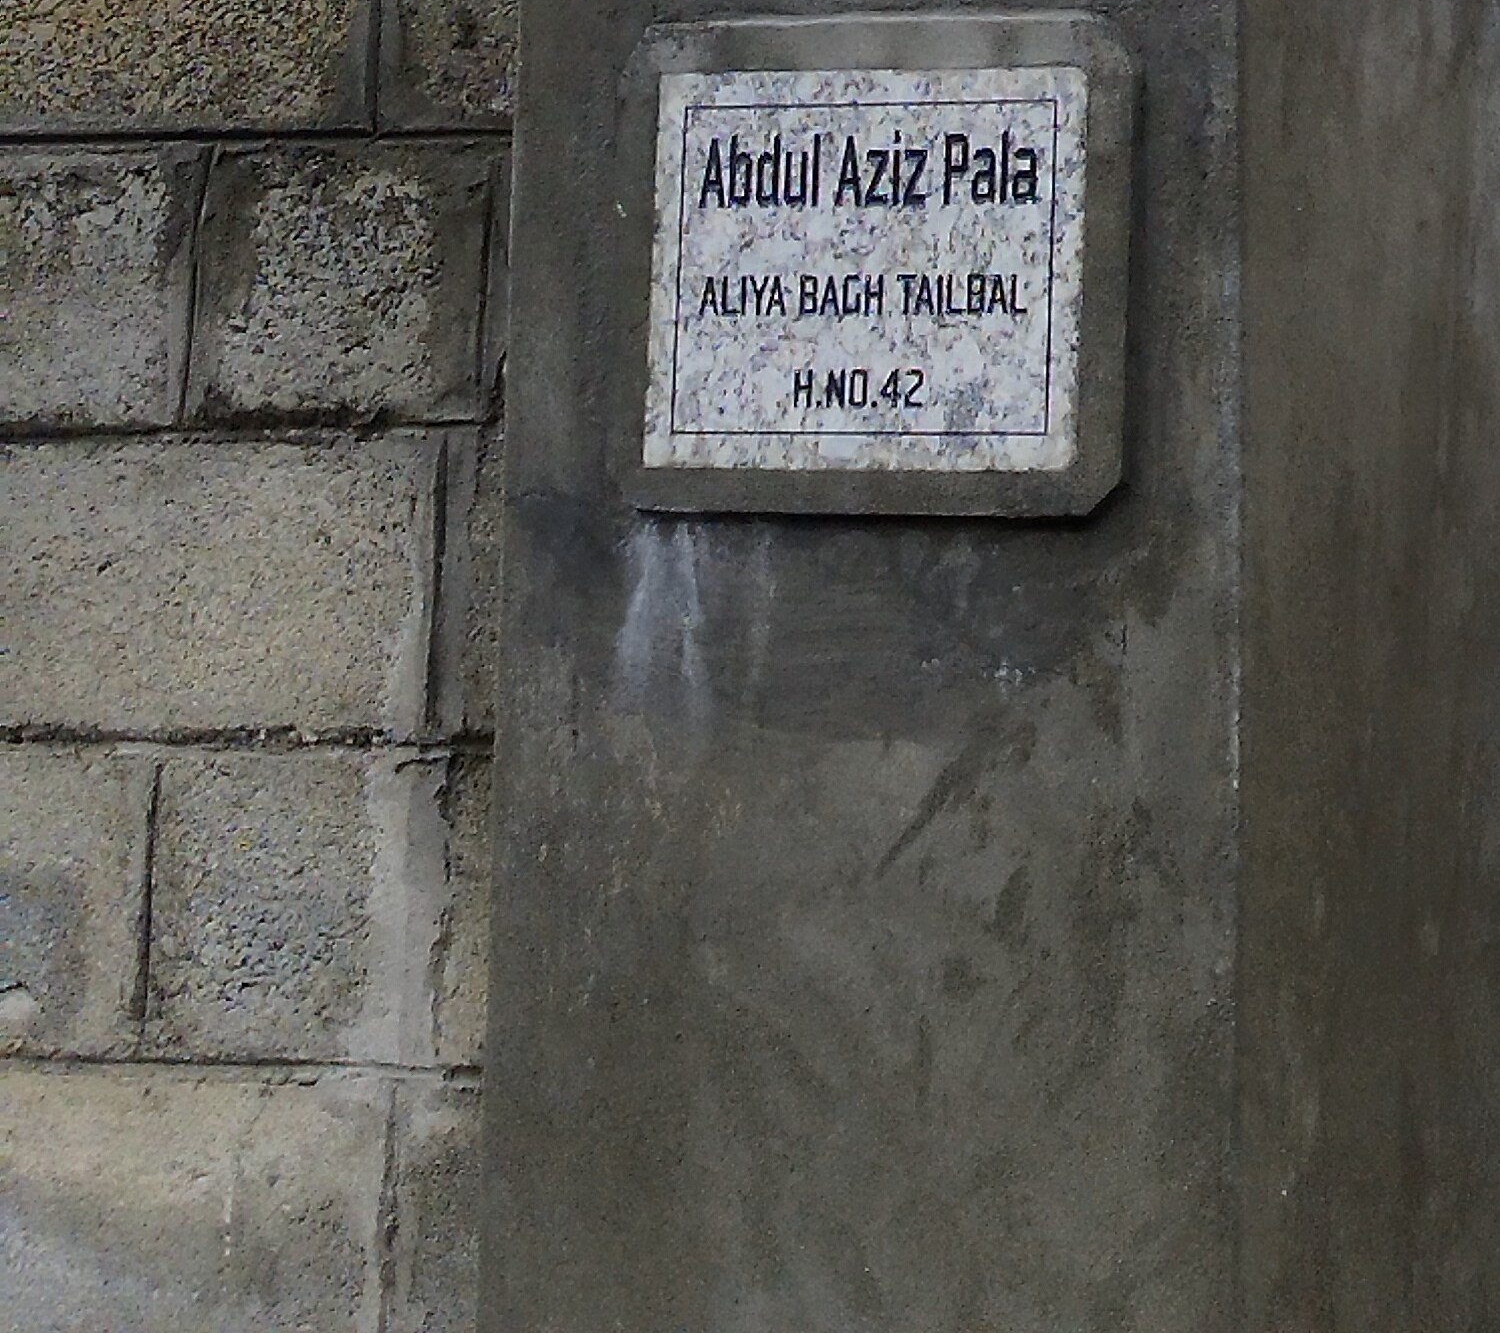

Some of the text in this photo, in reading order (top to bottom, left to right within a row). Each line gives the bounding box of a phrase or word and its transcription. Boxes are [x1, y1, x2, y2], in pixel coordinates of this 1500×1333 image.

[699, 130, 1039, 209] Abdul Aziz Pala
[699, 273, 1028, 316] ALIYA BAGH TAILBAL
